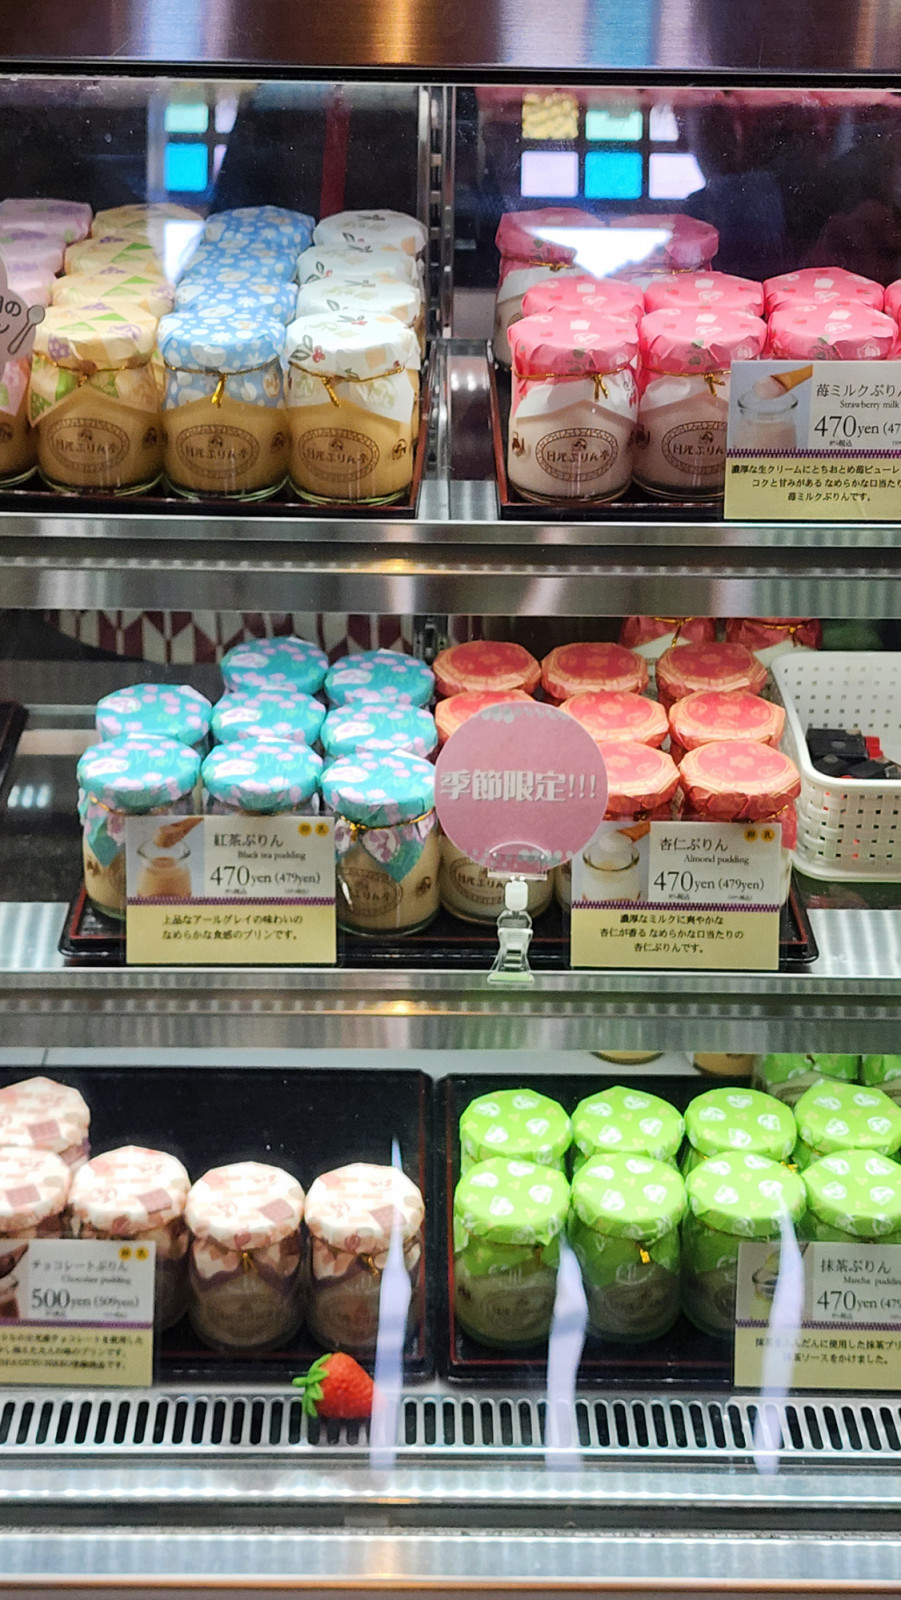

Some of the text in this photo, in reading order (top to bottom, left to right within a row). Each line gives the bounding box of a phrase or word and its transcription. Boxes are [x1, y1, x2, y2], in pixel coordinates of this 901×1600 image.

[839, 400, 899, 409] Strawberry milk
[673, 443, 725, 456] 日光ぷりん
[440, 769, 597, 801] 季節限定!!!
[214, 833, 284, 848] 紅茶ぷりん
[659, 838, 728, 851] 杏仁ぷりん
[274, 851, 306, 862] pudding
[684, 854, 750, 866] Almond pudding
[718, 877, 765, 892] (479yen)
[162, 914, 303, 925] 上品なアールグレイの味わいの
[162, 930, 298, 940] なめらかな食感のプリンです。
[820, 1258, 891, 1273] 抹茶ぷりん
[875, 1277, 901, 1287] puddin
